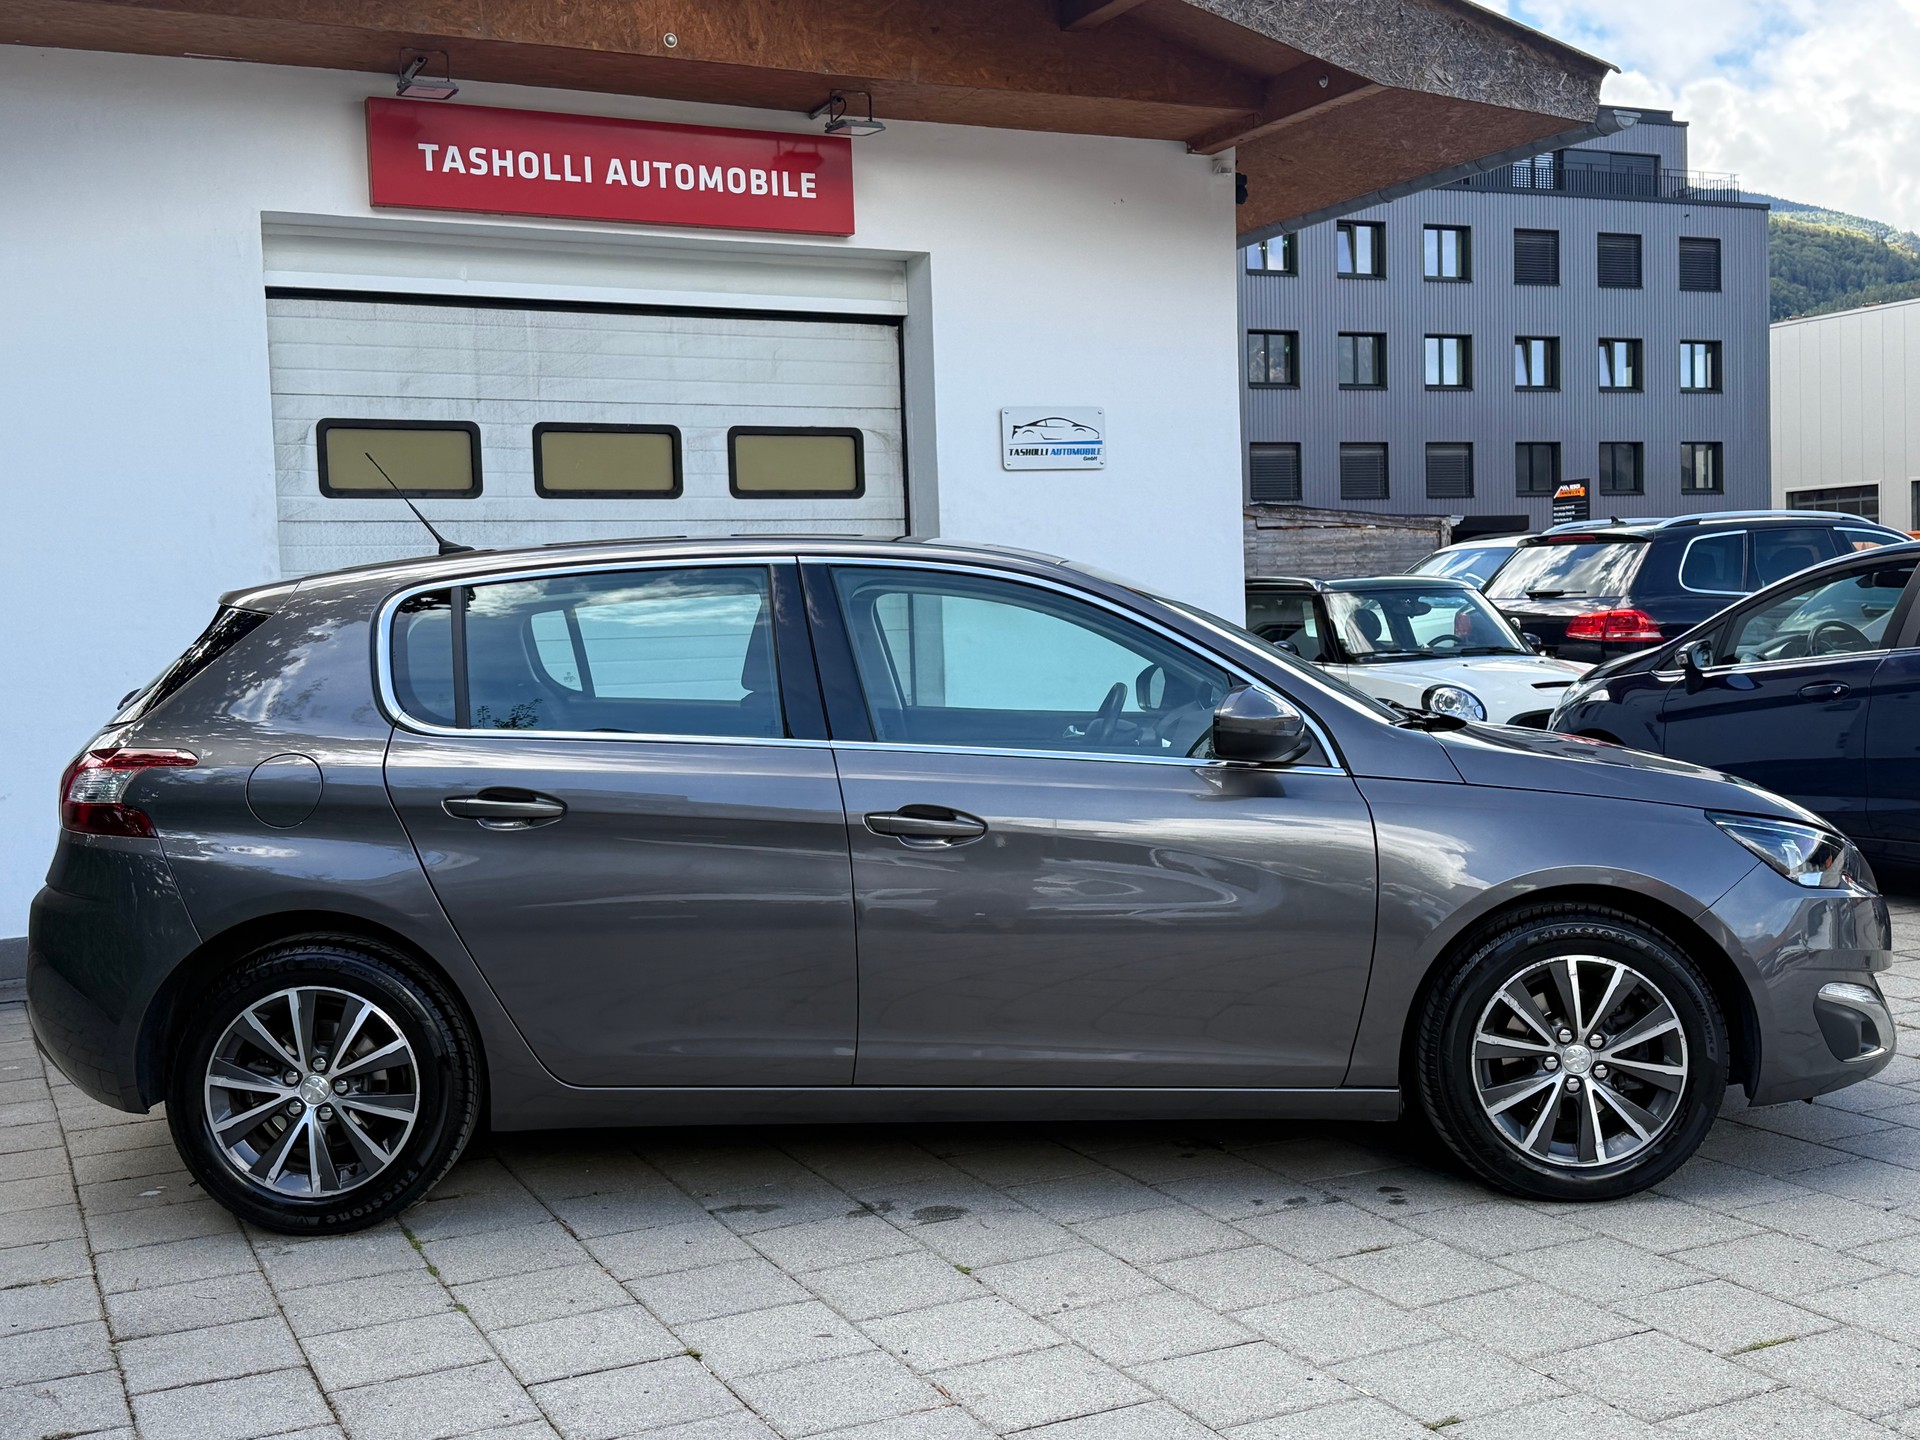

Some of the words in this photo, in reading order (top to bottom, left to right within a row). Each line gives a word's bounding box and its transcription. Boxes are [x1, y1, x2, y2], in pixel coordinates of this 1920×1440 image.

[417, 142, 592, 184] TASHOLLI
[605, 157, 817, 199] AUTOMOBILE
[1008, 448, 1049, 456] TASHOLLI
[1050, 447, 1102, 456] AUTOMOBILE
[1536, 926, 1639, 946] Firestone
[325, 1167, 421, 1225] Firestone
